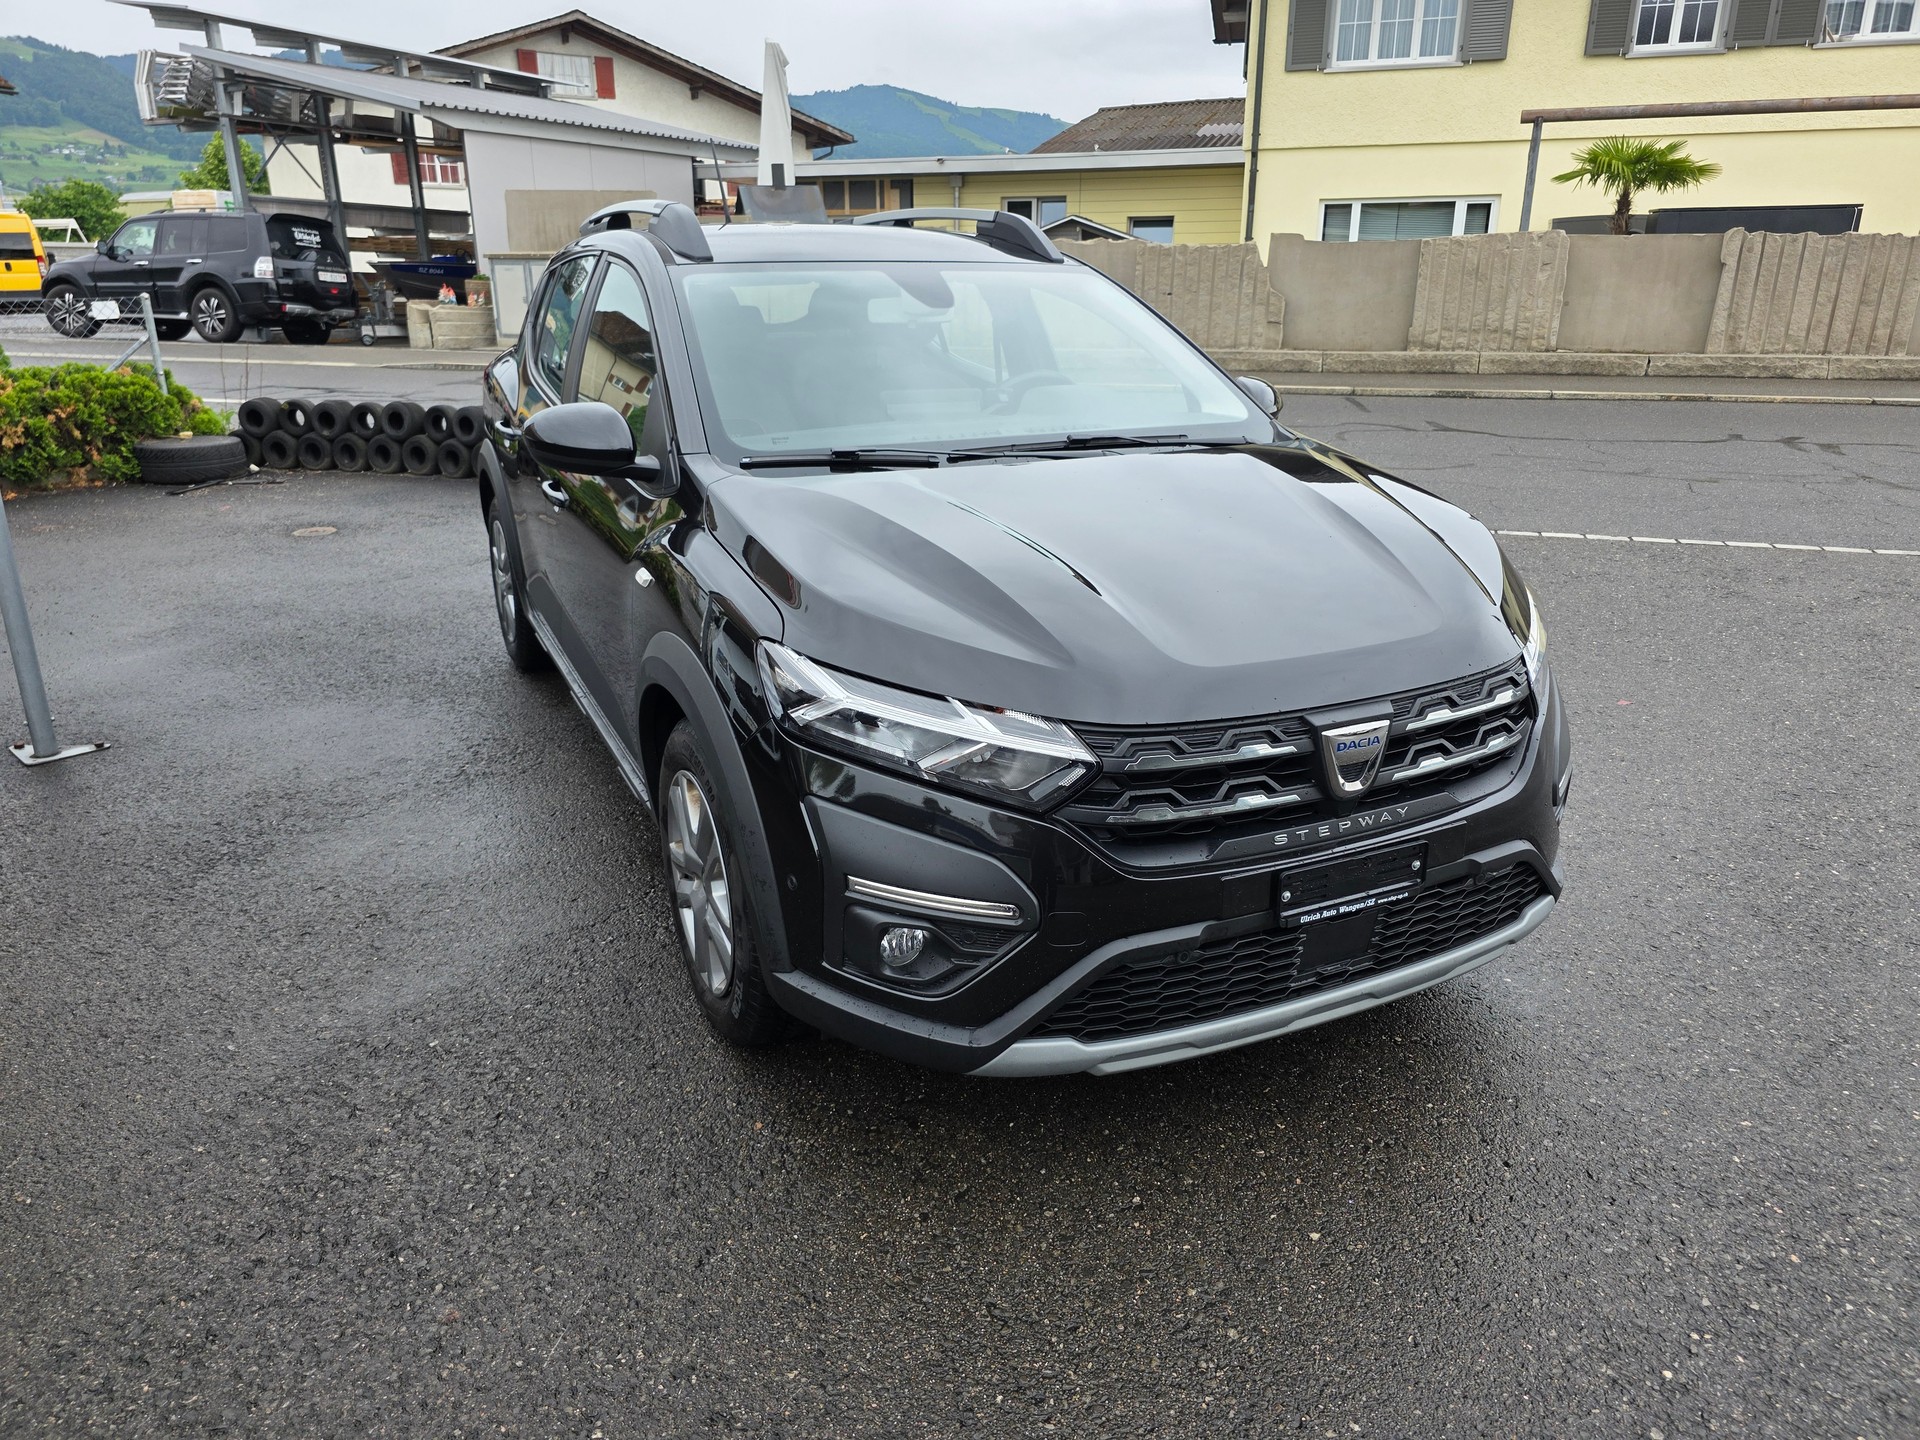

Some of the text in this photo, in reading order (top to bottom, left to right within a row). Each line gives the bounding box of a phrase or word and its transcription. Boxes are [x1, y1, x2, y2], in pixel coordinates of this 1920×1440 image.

[1336, 735, 1381, 752] DACIA
[1273, 806, 1409, 845] STEPWAY
[1300, 913, 1321, 923] Ulrich
[1321, 909, 1337, 918] Auto
[1339, 898, 1376, 913] Wangen/SZ
